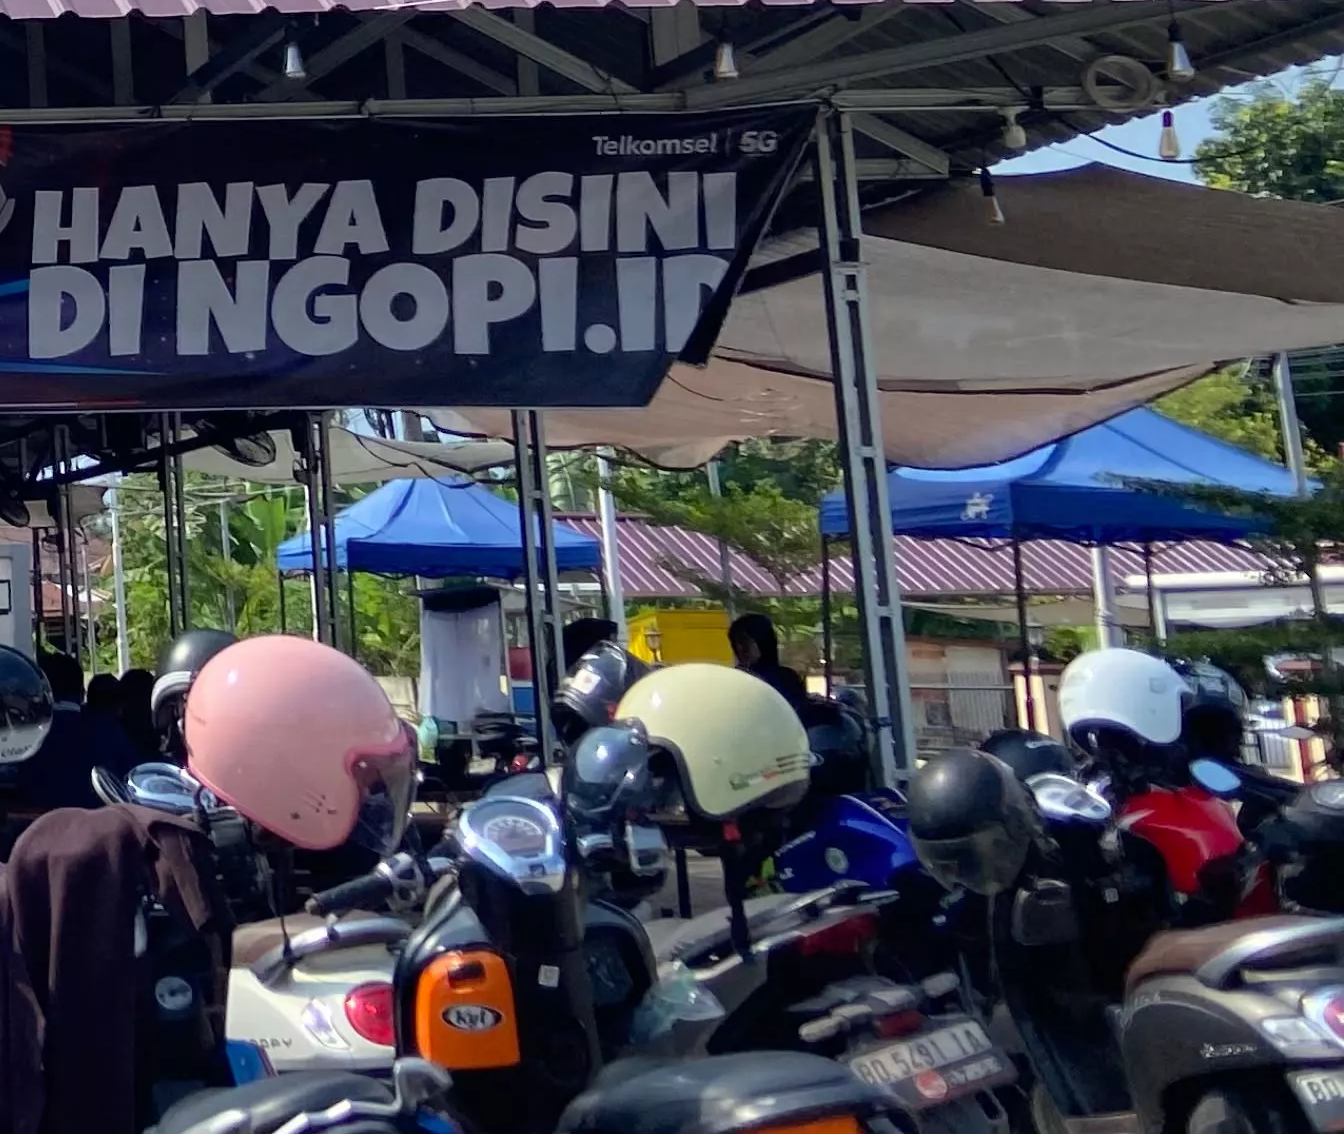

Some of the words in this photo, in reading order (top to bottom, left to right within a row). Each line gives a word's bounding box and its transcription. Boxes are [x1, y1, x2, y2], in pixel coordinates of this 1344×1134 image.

[592, 131, 719, 156] Telkomsel
[738, 129, 779, 156] 5G
[30, 179, 390, 264] HANYA
[412, 171, 736, 254] DISINI
[28, 265, 145, 358] DI
